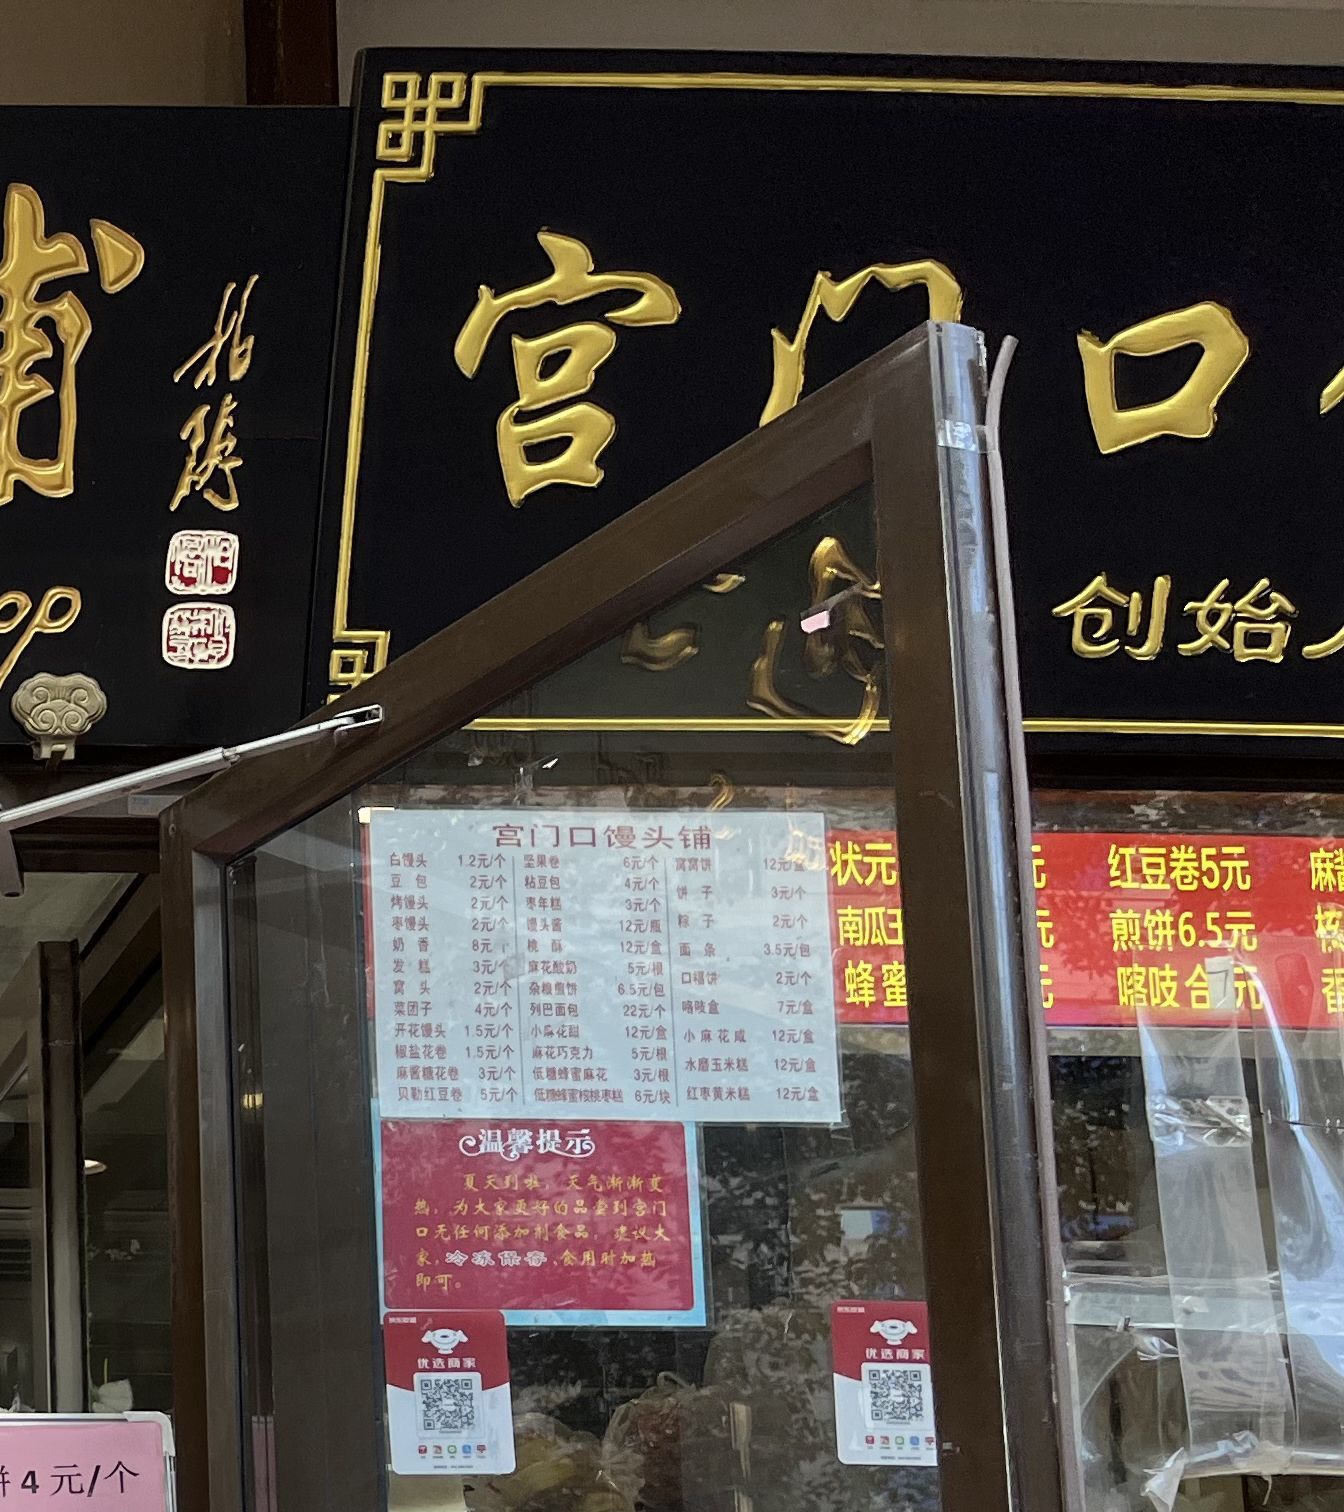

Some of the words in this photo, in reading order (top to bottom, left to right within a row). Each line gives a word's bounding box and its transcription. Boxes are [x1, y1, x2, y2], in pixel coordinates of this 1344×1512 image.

[453, 225, 1344, 508] 宫门口
[1052, 572, 1344, 663] 创始
[492, 824, 712, 850] 宫门口馒头铺
[389, 852, 427, 868] 白馒头
[623, 855, 659, 871] 6元/个
[829, 840, 897, 886] 状元
[1107, 844, 1251, 891] 红豆卷5元
[470, 874, 507, 889] 2元/个
[524, 875, 560, 889] 粘豆包
[624, 877, 659, 891] 4元/个
[771, 886, 806, 900] 3元/个
[471, 895, 509, 911] 2元/个
[625, 898, 661, 913] 3元/个
[772, 914, 808, 929] 2元/个
[1109, 908, 1257, 952] 煎饼6.5元
[620, 940, 662, 954] 12元/盒
[763, 943, 810, 957] 3.5元/包
[776, 971, 812, 986] 2元/个
[844, 959, 908, 1008] 蜂蜜
[473, 980, 511, 996] 2元/个
[617, 983, 665, 997] 6.5元/包
[394, 1001, 432, 1017] 菜团子
[474, 1002, 512, 1018] 4元/个
[529, 1002, 579, 1017] 列巴面包
[623, 1004, 666, 1019] 22元/个
[777, 1000, 814, 1015] 7元/盒
[625, 1025, 667, 1040] 12元/盒
[772, 1029, 815, 1044] 12元/盒
[532, 1045, 593, 1060] 麻花巧克力
[774, 1057, 816, 1072] 12元/盒
[478, 1066, 516, 1081] 3元/个
[480, 1087, 518, 1103] 5元/个
[634, 1089, 671, 1104] 6元/块
[776, 1086, 819, 1101] 12元/盒
[462, 1128, 595, 1159] 温馨提示
[865, 1347, 925, 1360] 优选商家
[417, 1357, 476, 1369] 优选商家
[21, 1471, 39, 1494] 4
[50, 1461, 140, 1498] 元/个
